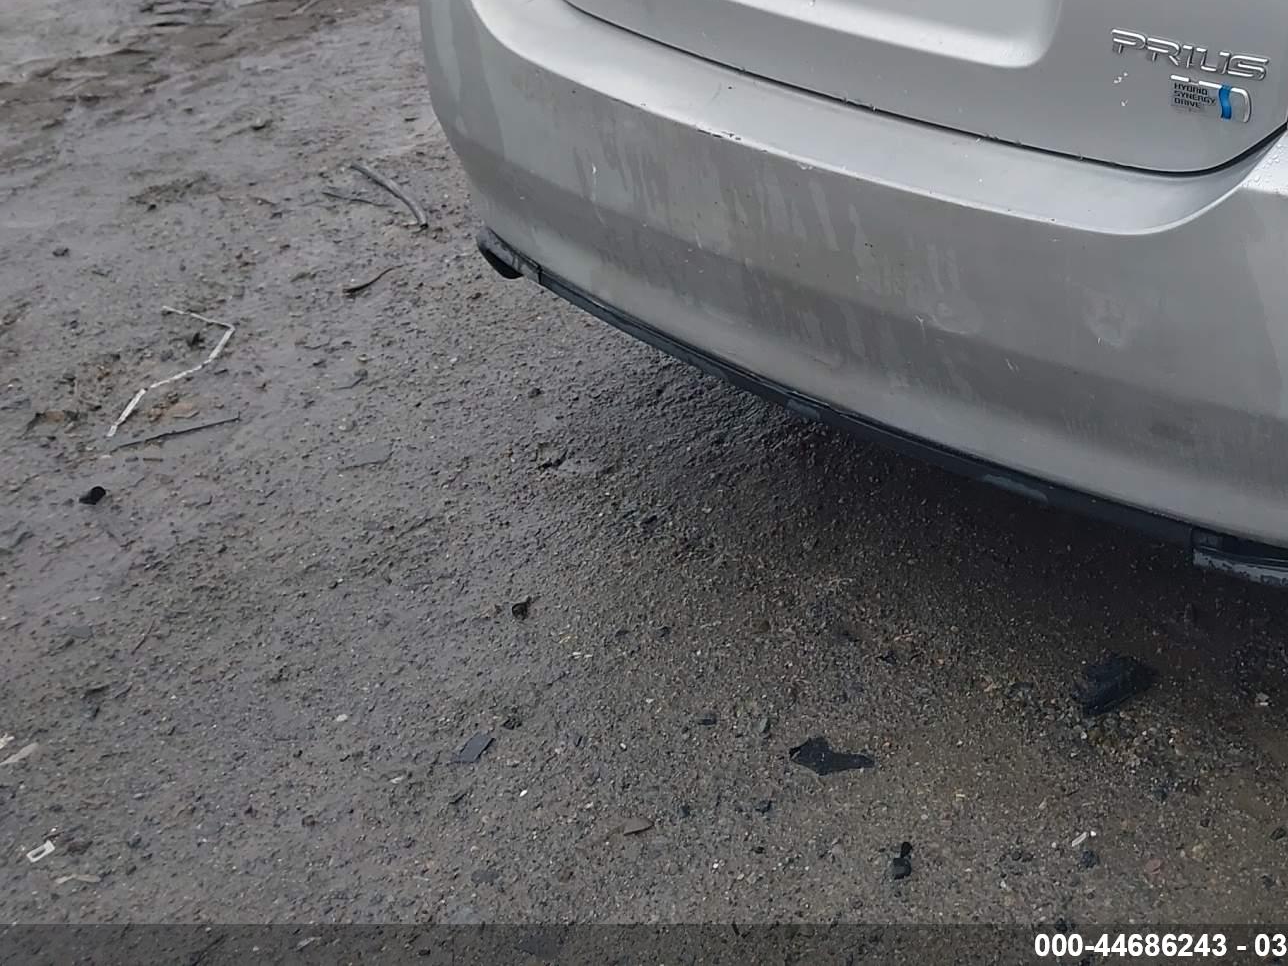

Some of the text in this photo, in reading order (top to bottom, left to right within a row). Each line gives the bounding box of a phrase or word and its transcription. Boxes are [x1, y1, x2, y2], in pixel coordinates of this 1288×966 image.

[1111, 28, 1270, 81] PRIUS
[1173, 82, 1208, 96] HYBRID
[1173, 90, 1217, 105] SYNERGY
[1173, 97, 1201, 109] DRIVE
